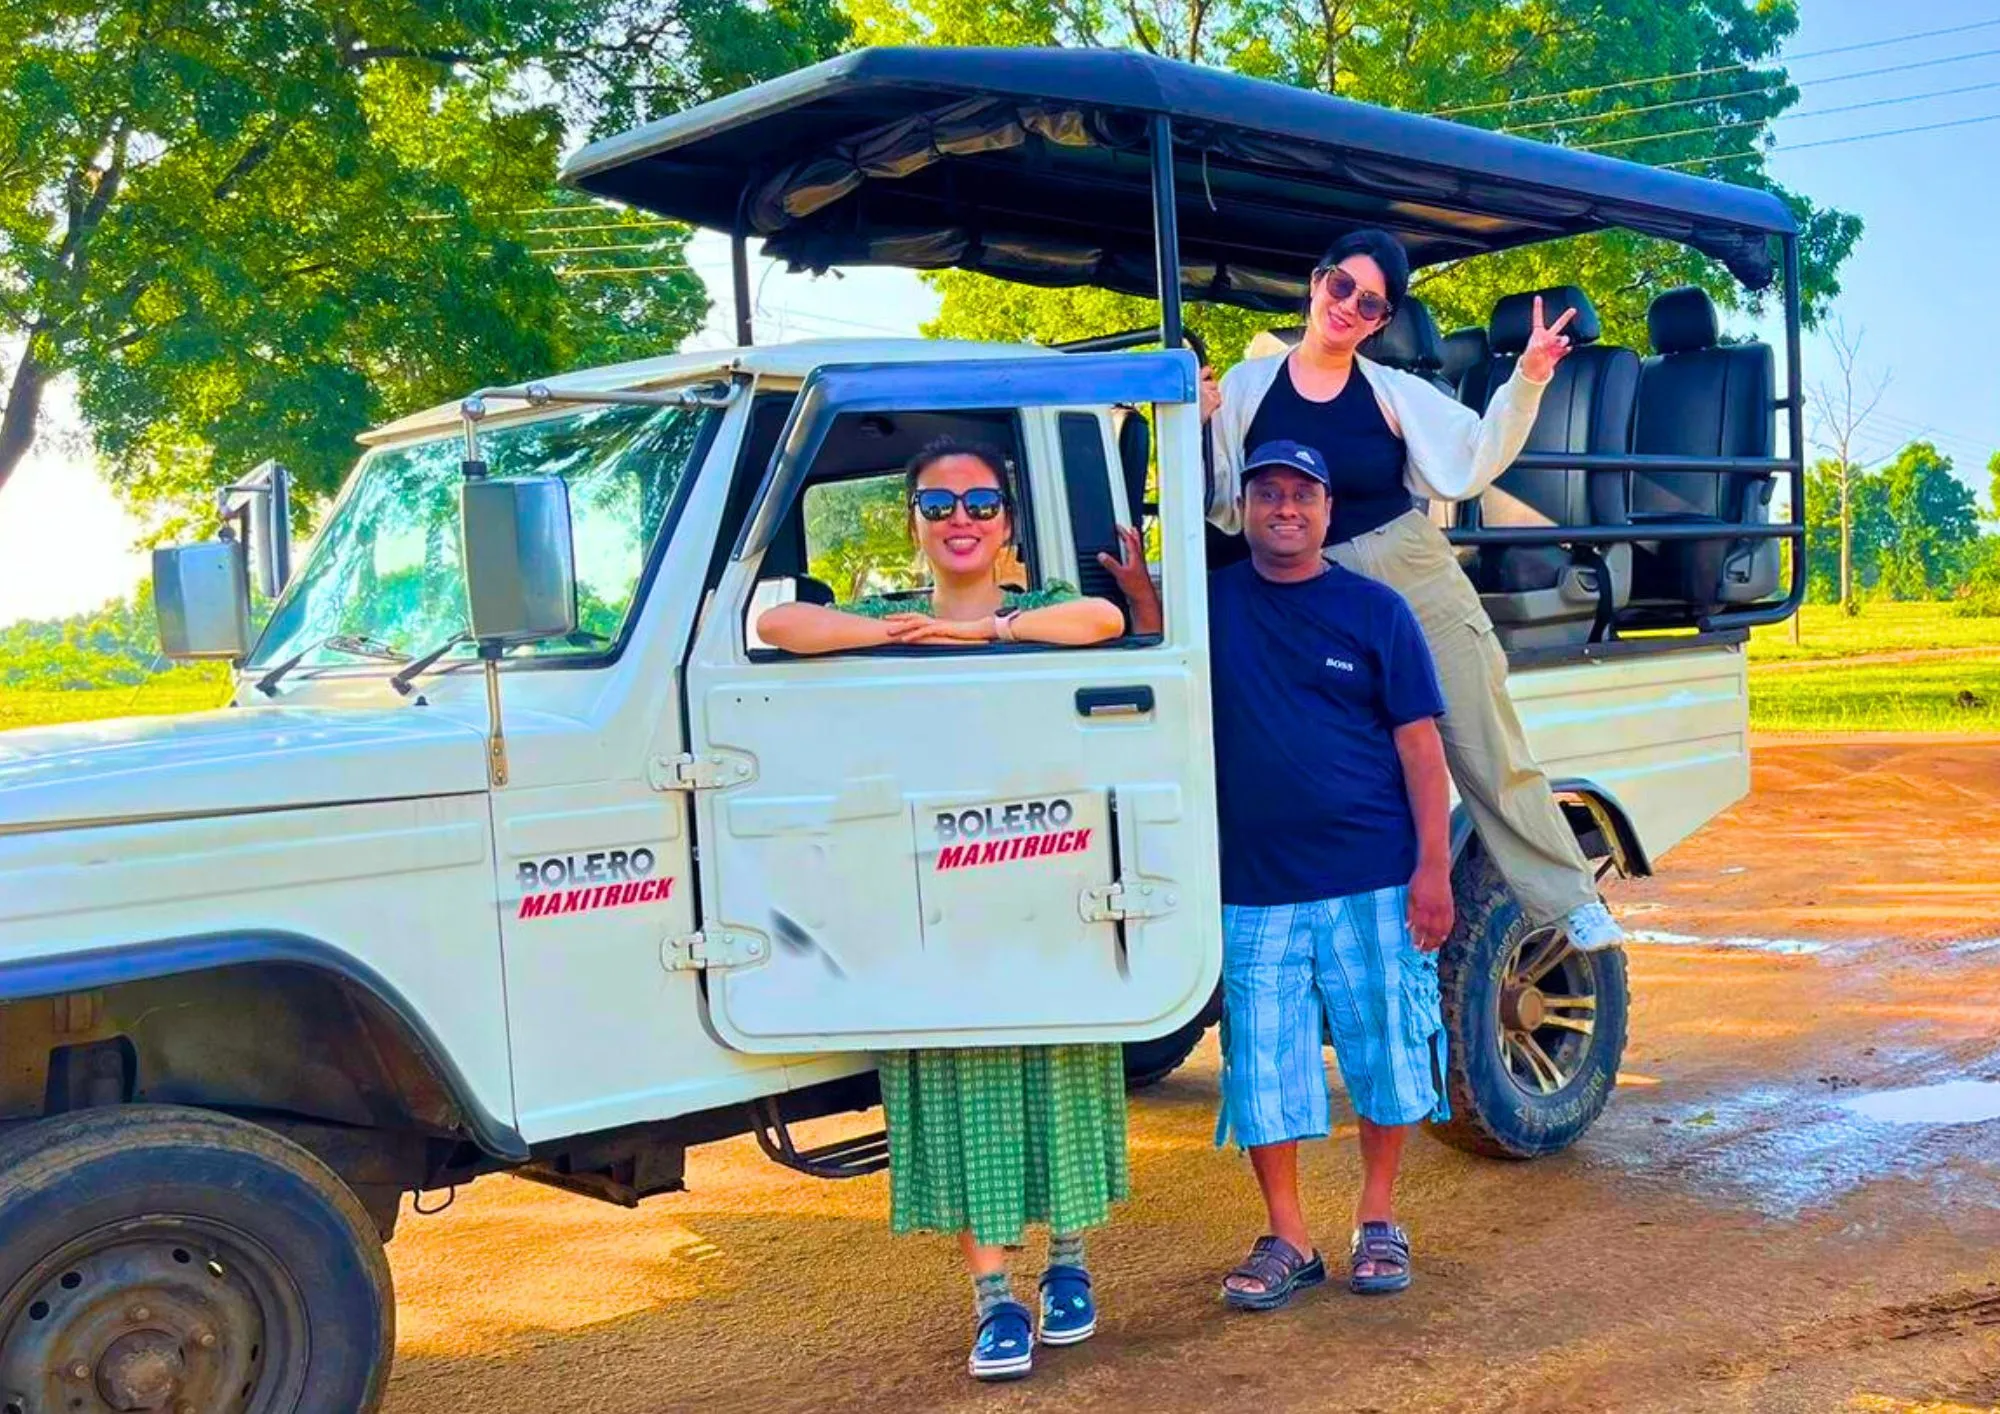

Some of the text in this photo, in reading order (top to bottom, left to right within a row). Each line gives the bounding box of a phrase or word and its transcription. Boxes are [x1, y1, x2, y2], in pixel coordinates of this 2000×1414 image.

[1325, 657, 1353, 672] BOSS
[935, 799, 1073, 843] BOLERO
[516, 847, 655, 891] BOLERO
[936, 827, 1092, 871] MAXITRUCK
[518, 875, 675, 919] MAXITRUCK
